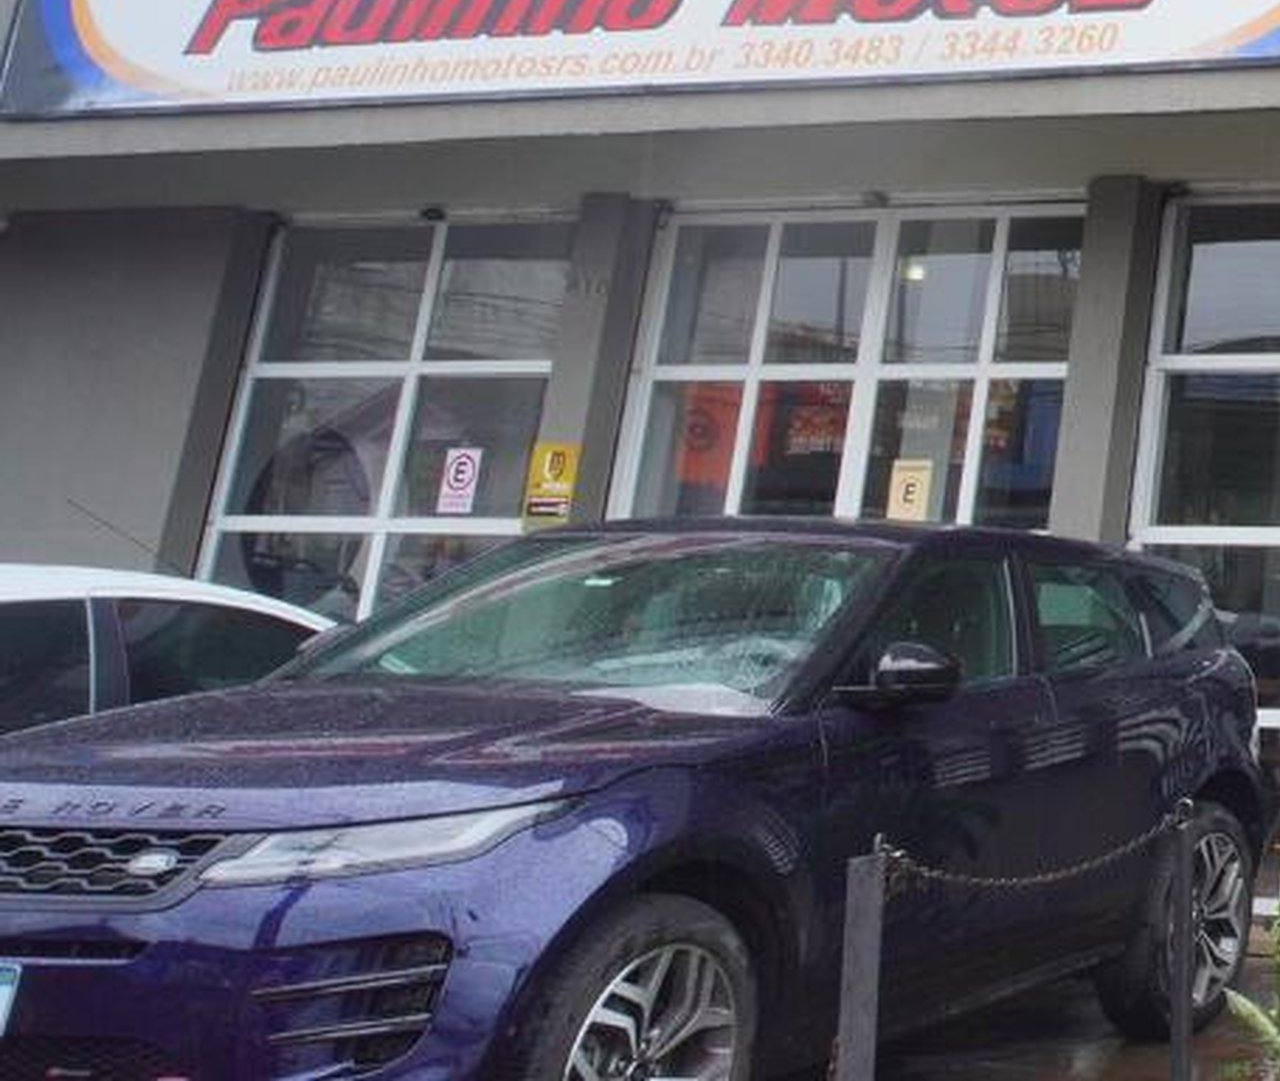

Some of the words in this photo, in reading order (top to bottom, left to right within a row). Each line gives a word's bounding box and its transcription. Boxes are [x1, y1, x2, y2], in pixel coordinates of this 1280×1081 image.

[227, 44, 722, 96] www.paulinhomotosrs.com.br
[454, 461, 469, 483] E
[903, 483, 917, 505] E
